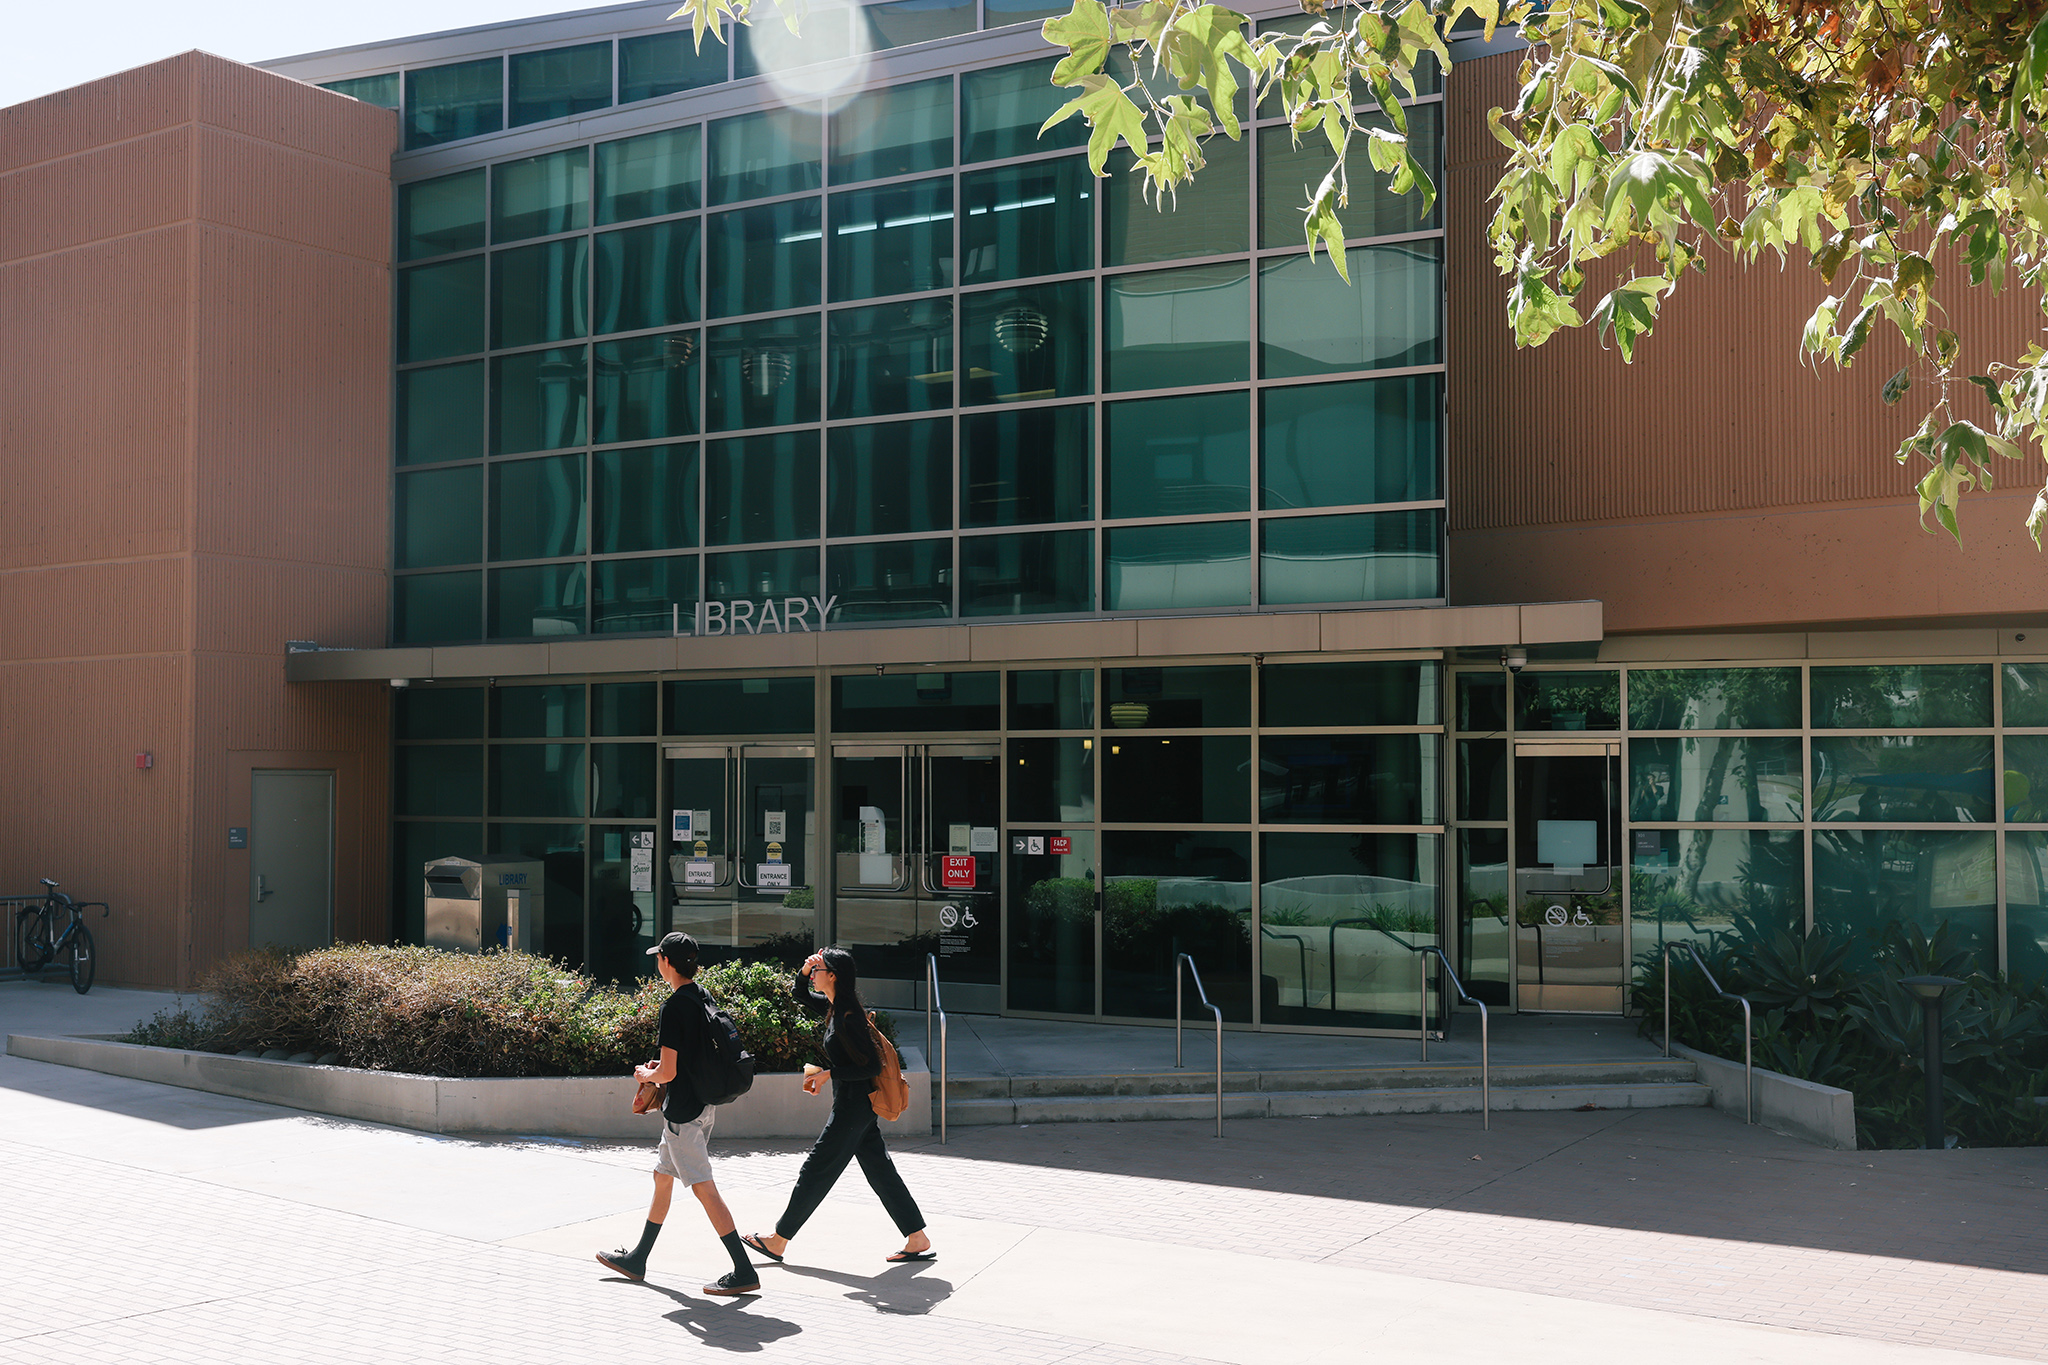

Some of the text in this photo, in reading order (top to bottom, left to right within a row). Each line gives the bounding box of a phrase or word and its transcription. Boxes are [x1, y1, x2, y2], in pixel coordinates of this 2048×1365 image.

[673, 595, 837, 637] LIBRARY
[949, 858, 968, 866] EXIT
[760, 872, 787, 880] ENTRANCE
[947, 869, 970, 878] ONLY
[498, 872, 527, 886] LIBRARY
